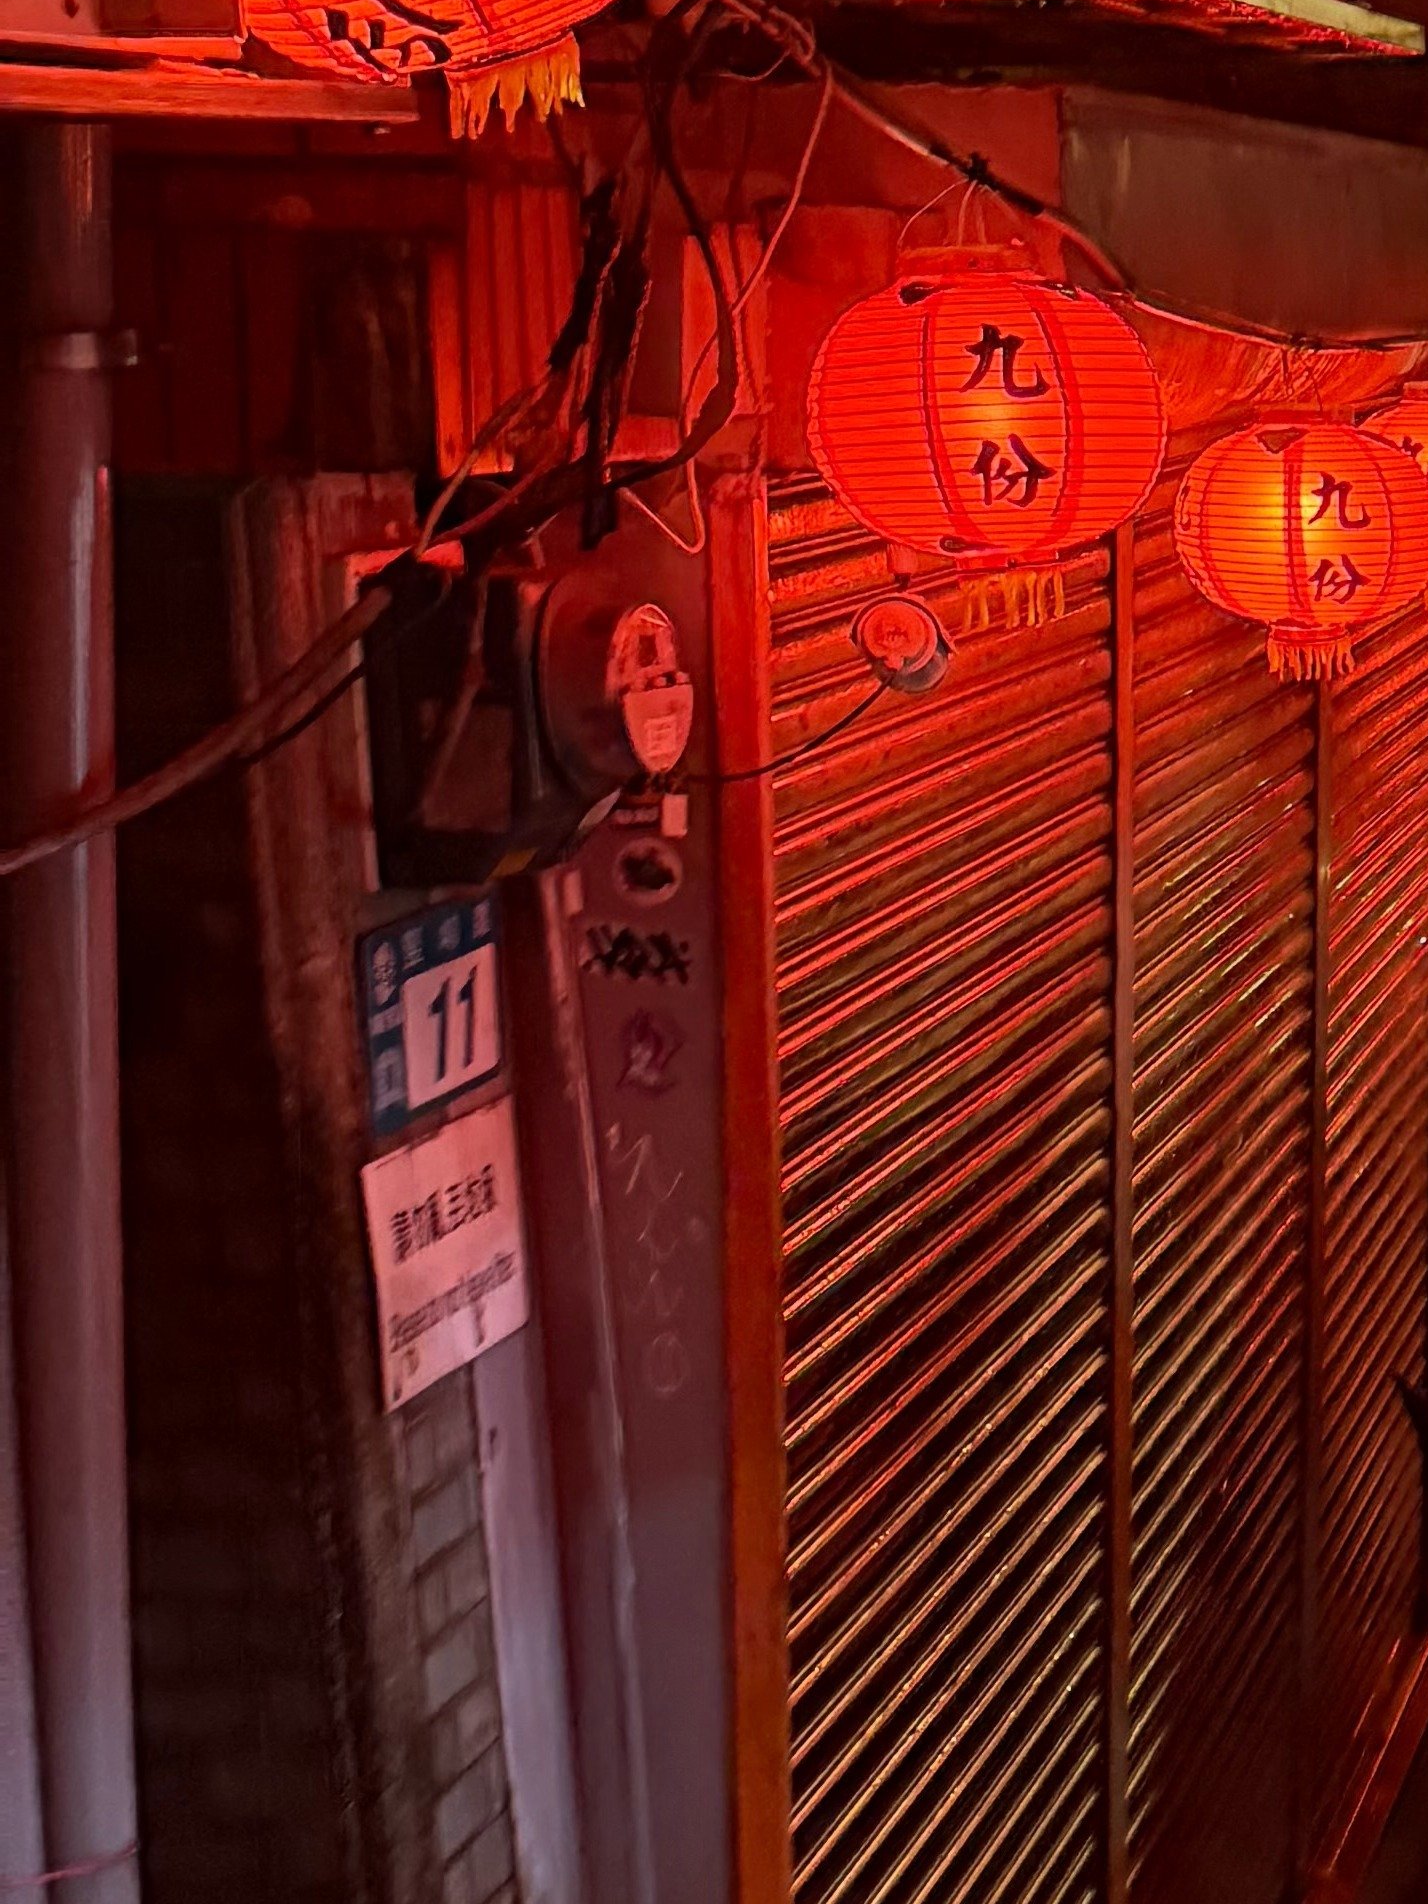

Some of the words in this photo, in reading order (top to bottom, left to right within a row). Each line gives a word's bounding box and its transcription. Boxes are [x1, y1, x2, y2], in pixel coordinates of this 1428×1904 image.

[958, 322, 1057, 508] 九份
[1308, 471, 1371, 604] 九份
[427, 966, 478, 1083] 11
